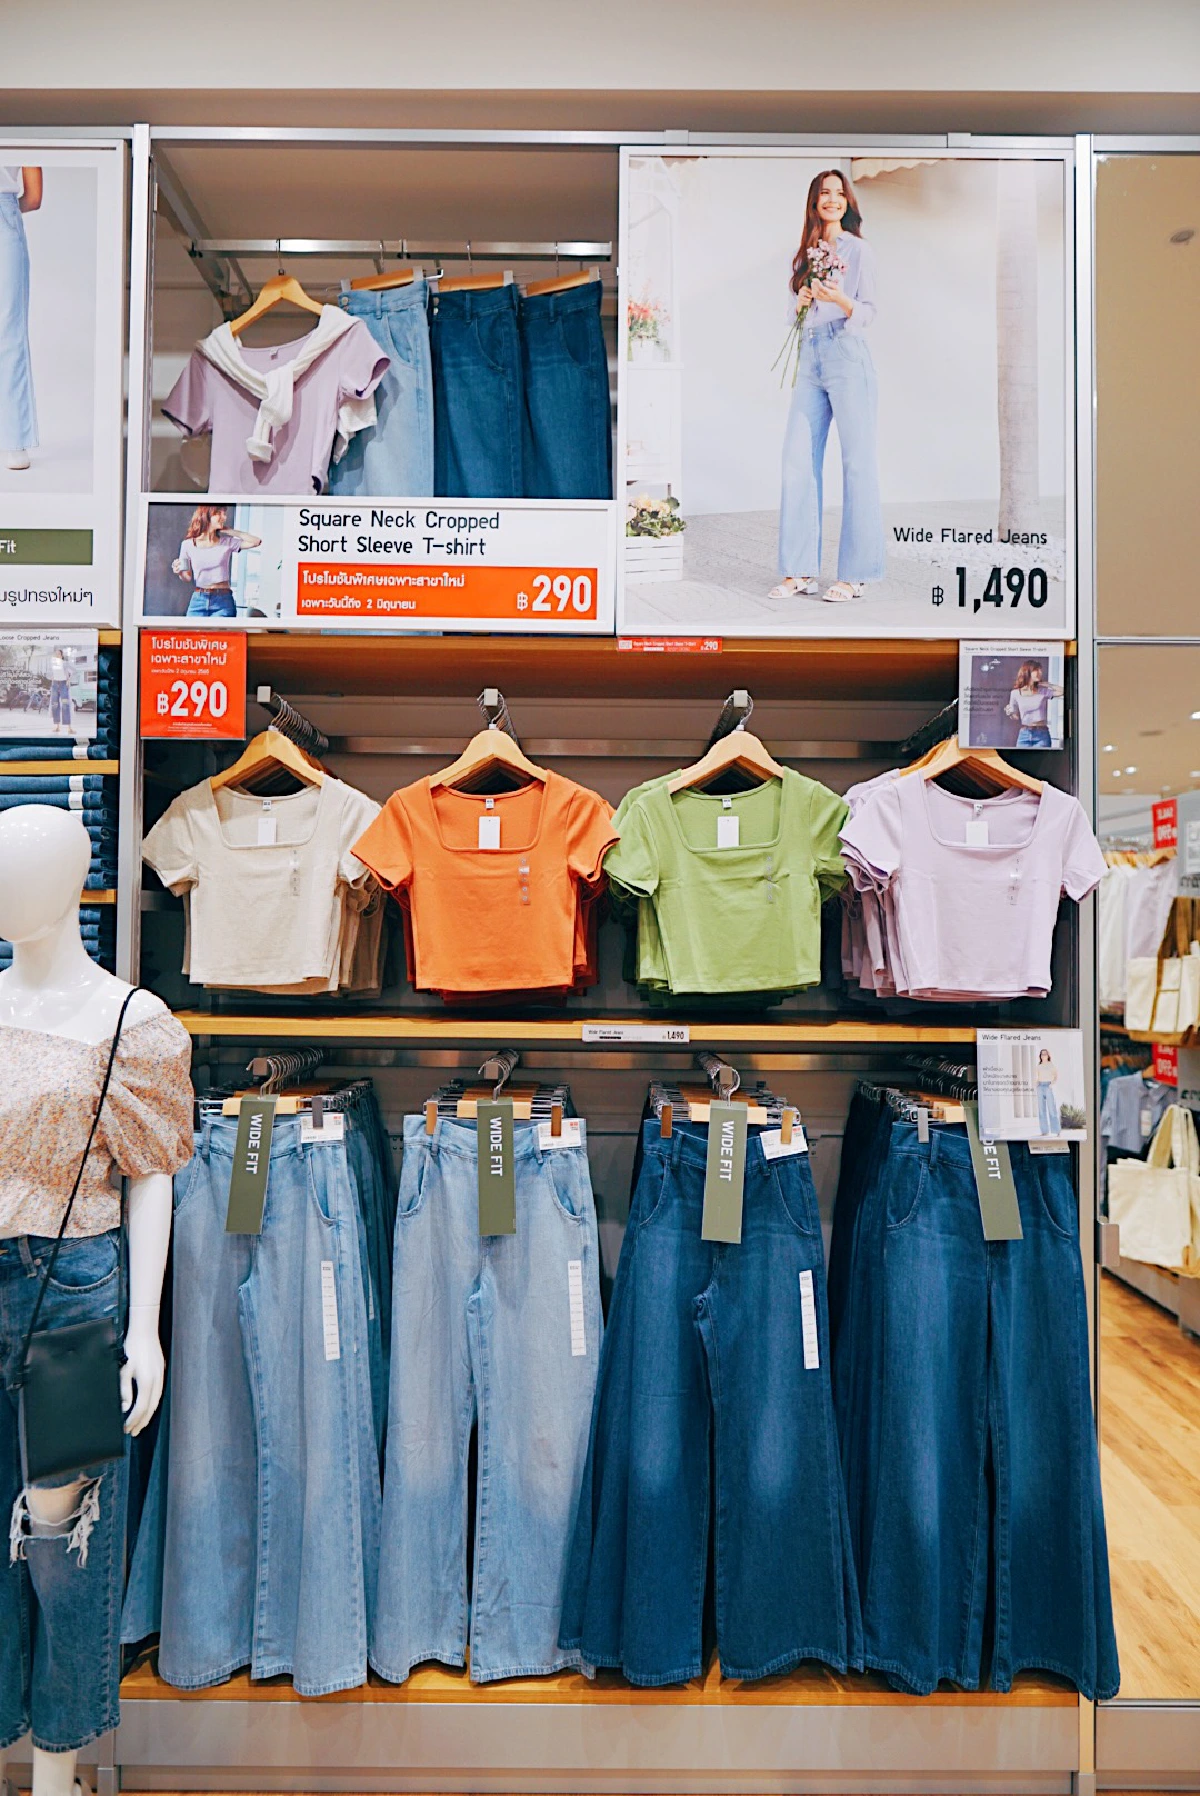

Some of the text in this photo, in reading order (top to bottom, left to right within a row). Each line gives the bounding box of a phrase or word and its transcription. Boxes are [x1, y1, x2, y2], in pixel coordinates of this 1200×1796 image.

[299, 508, 500, 533] Square Neck Cropped
[298, 535, 487, 556] Short Sleeve T-shirt
[893, 527, 1048, 544] Wide Flared Jeans
[956, 566, 1048, 614] 1,490
[366, 598, 373, 609] 2
[151, 636, 228, 650] โปรโมชันพิเศษ
[150, 651, 228, 666] เฉพาะสาขาใหม่
[245, 1114, 263, 1175] WIDE FIT
[490, 1117, 503, 1176] WIDE FIT
[719, 1120, 734, 1181] WIDE FIT
[986, 1158, 1001, 1179] FIT
